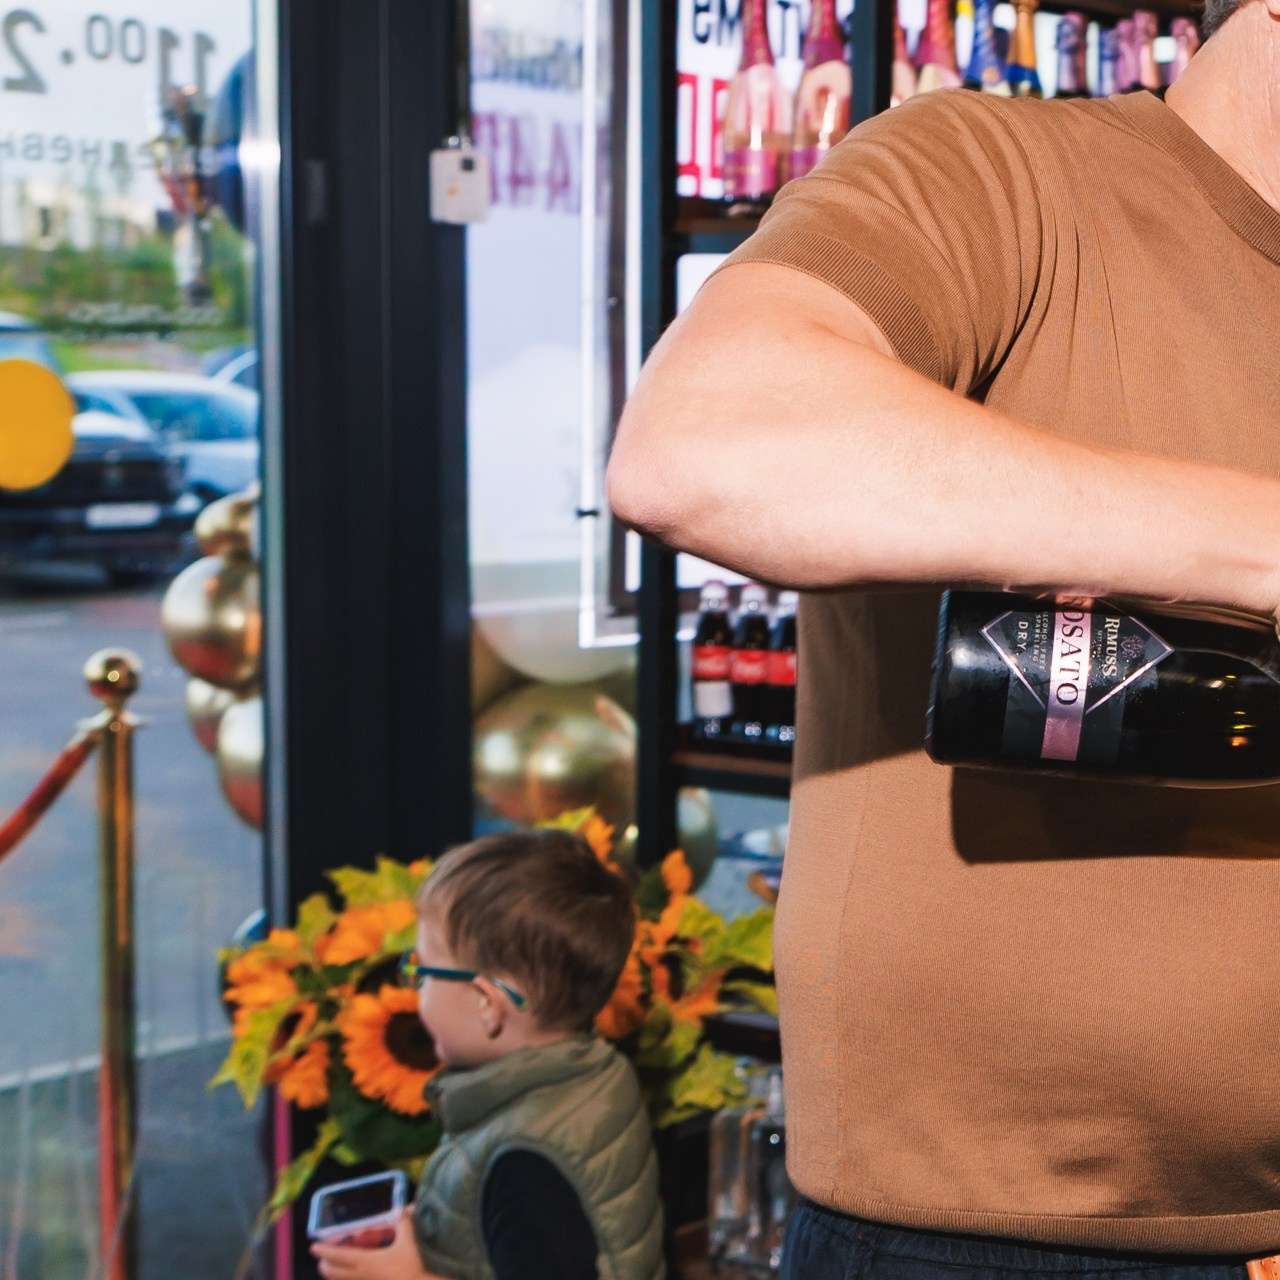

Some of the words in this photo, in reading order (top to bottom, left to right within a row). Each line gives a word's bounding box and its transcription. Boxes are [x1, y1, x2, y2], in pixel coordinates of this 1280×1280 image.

[1016, 621, 1029, 651] DRY
[1032, 614, 1042, 662] SPARKLING
[1101, 616, 1121, 678] RIMUSS
